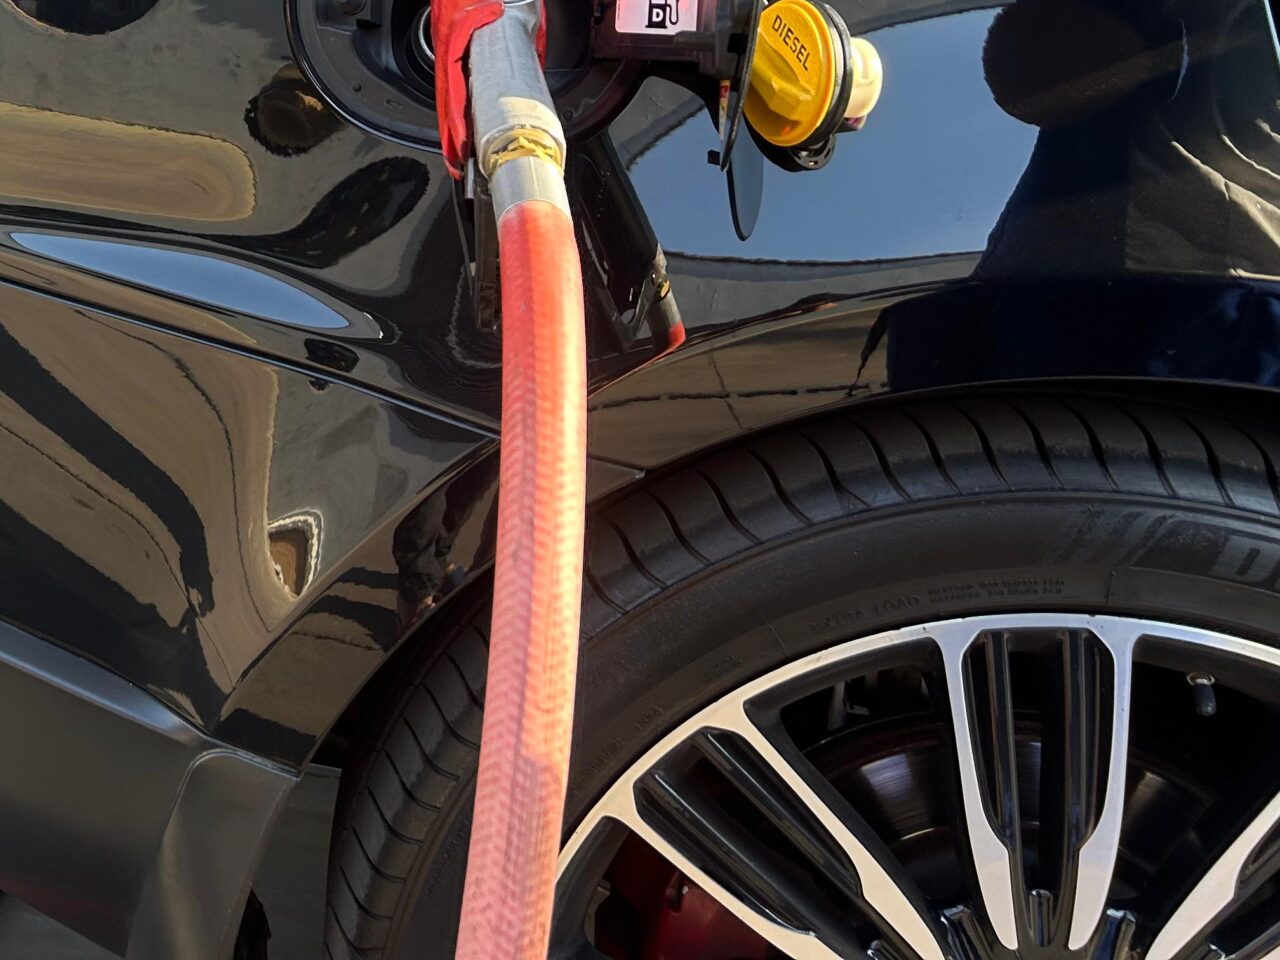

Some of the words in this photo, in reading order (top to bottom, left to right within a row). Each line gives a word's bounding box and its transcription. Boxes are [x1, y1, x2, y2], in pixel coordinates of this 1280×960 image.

[652, 8, 664, 22] D
[771, 13, 810, 72] DIESEL
[809, 607, 866, 633] EXTRA
[872, 592, 922, 617] LOAD
